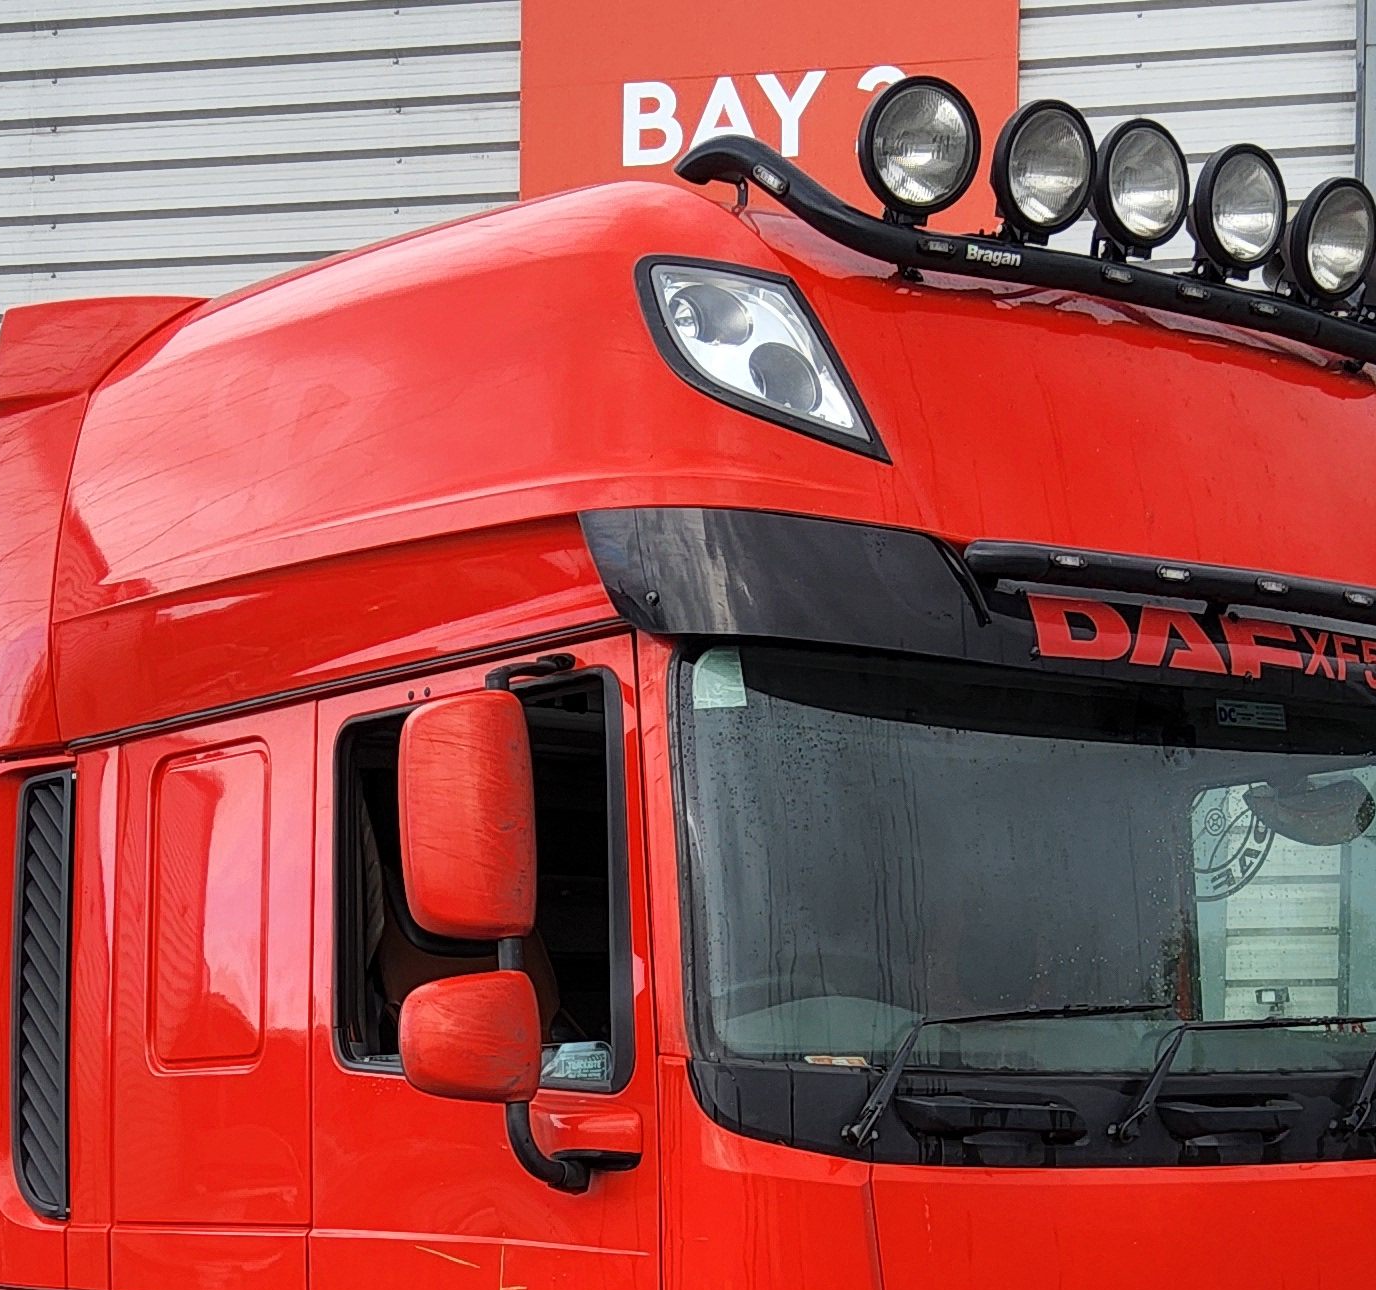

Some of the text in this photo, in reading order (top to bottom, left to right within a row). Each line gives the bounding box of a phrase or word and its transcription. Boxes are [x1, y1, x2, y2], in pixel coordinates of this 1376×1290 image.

[622, 71, 827, 167] BAY
[965, 243, 1022, 267] Bragan
[1026, 592, 1304, 680] DAF
